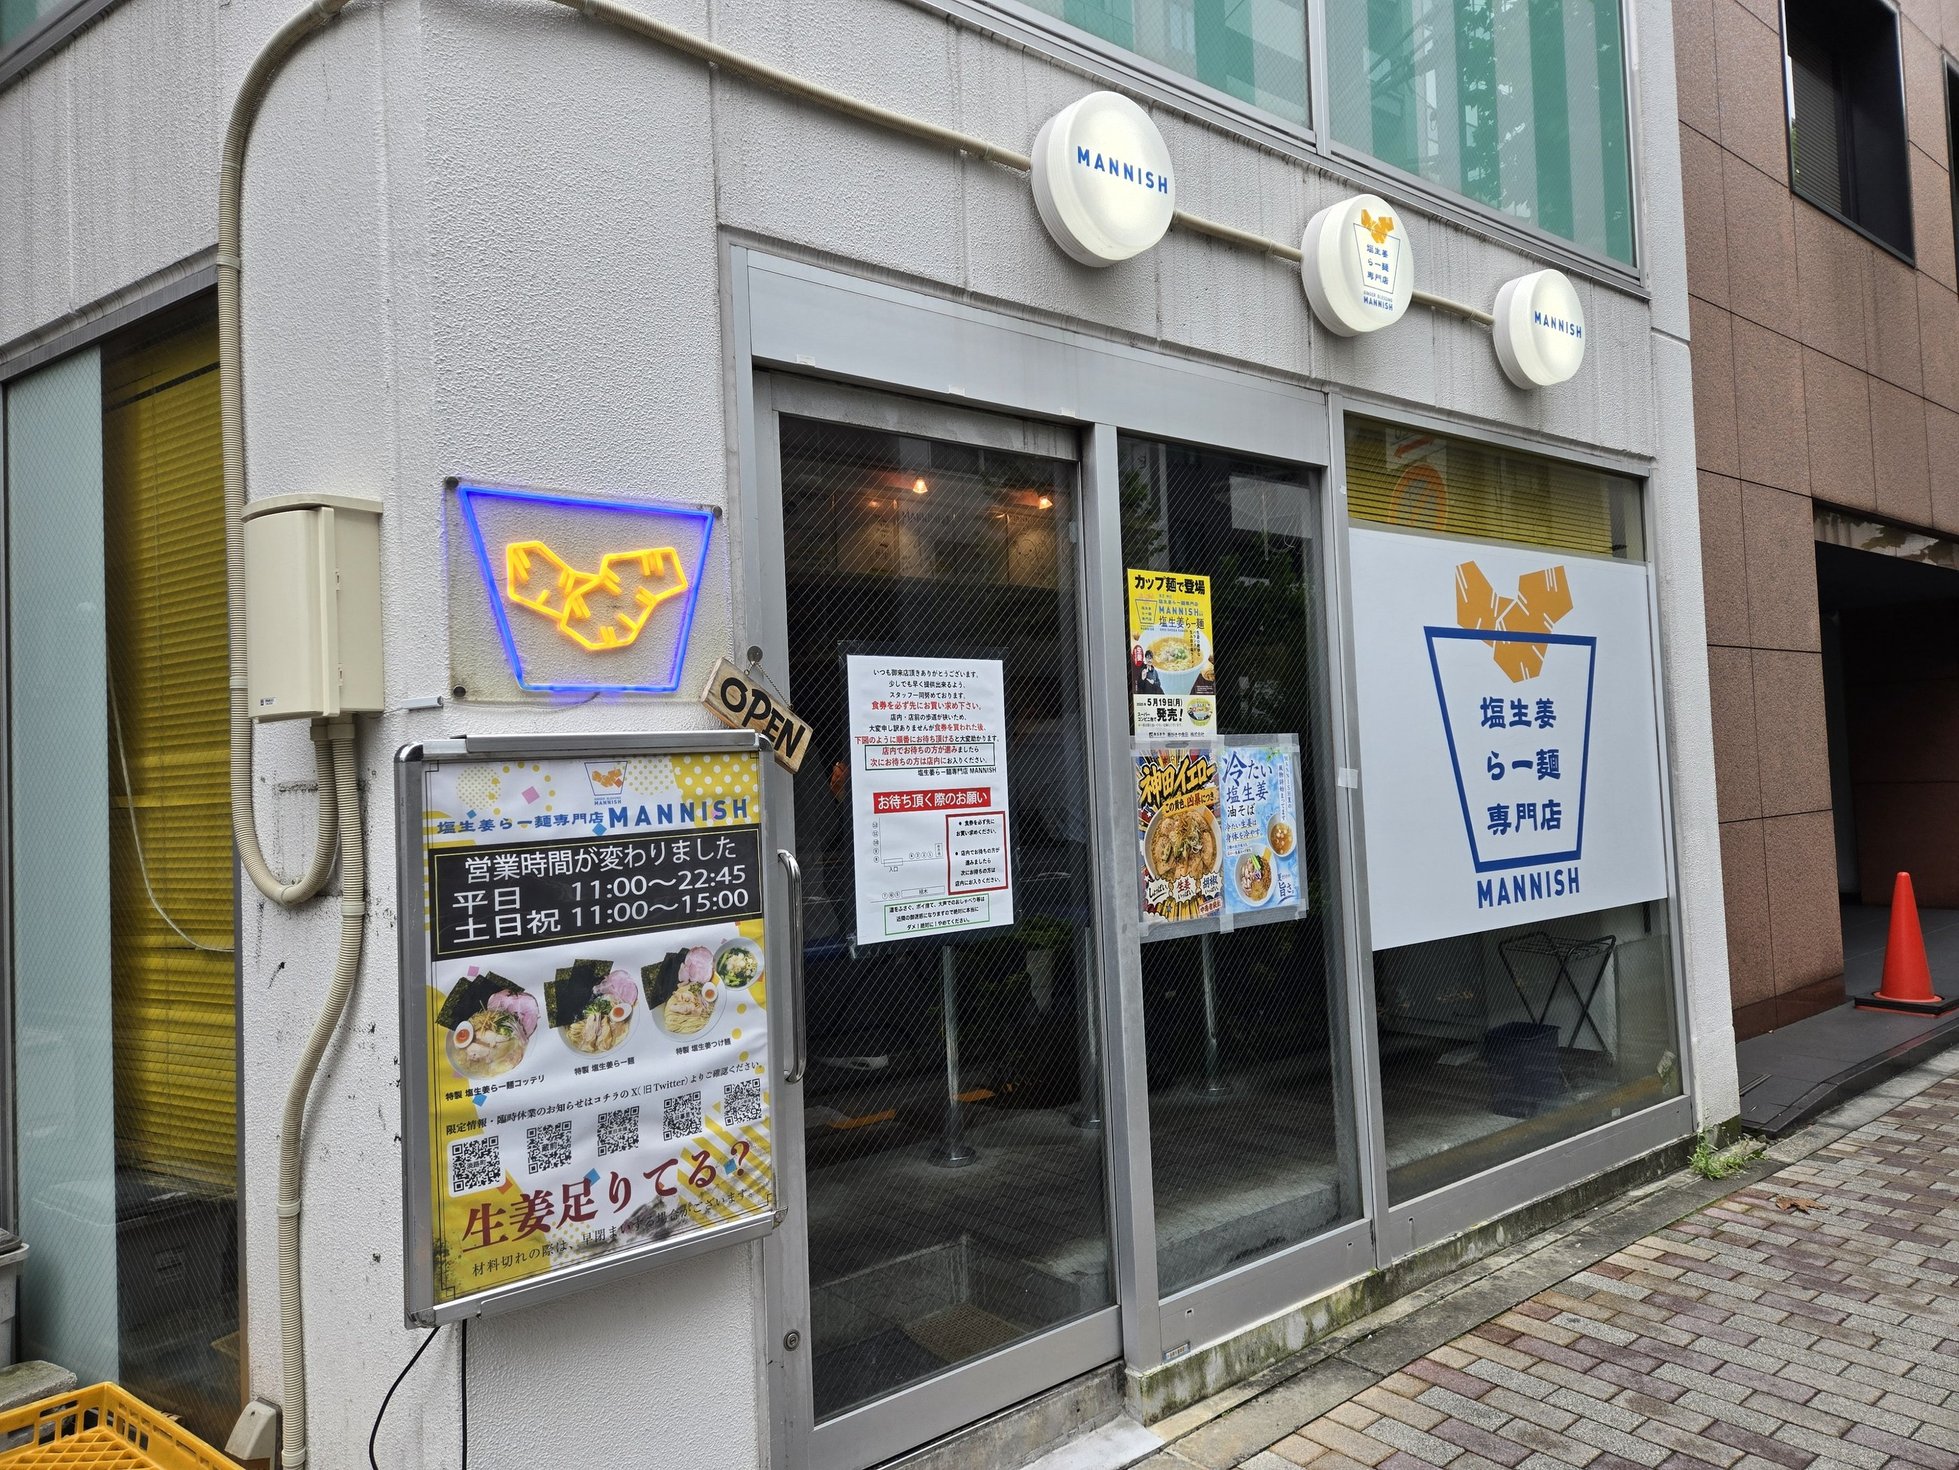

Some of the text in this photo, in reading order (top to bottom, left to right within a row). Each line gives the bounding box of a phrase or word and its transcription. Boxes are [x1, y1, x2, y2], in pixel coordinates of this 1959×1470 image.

[1077, 145, 1168, 195] MANNISH
[1363, 296, 1393, 311] MANNISH
[1534, 310, 1583, 339] MANNISH
[1134, 574, 1206, 595] カップ麺で登場
[1159, 606, 1199, 617] MANNISH
[1159, 615, 1205, 630] 塩生姜らー麺
[873, 669, 979, 679] いつも御来店頂きありがとうございます。
[720, 677, 806, 759] OPEN
[871, 700, 982, 711] 食券を必ず先にお買い求め下さい。
[1479, 696, 1557, 729] 塩生姜
[881, 745, 980, 756] 店内でお待ちの方が進みましたら
[1486, 748, 1561, 781] らー麺
[1139, 756, 1217, 806] 神田イエロー
[1222, 750, 1273, 787] 冷たい
[877, 792, 988, 810] お待ち頂く際のお願い
[1226, 780, 1269, 804] 塩生姜
[437, 798, 748, 834] 塩生姜らー麺専門店 MANNISH
[1227, 803, 1256, 818] 油そば
[1487, 799, 1562, 835] 専門店
[464, 836, 737, 884] 営業時間が変わりました
[1177, 878, 1191, 893] 生姜
[1202, 875, 1219, 889] 胡椒
[1477, 866, 1581, 909] MANNISH
[452, 886, 522, 916] 平日
[453, 909, 561, 944] 土日祝
[462, 1139, 750, 1253] 生姜足りてる?
